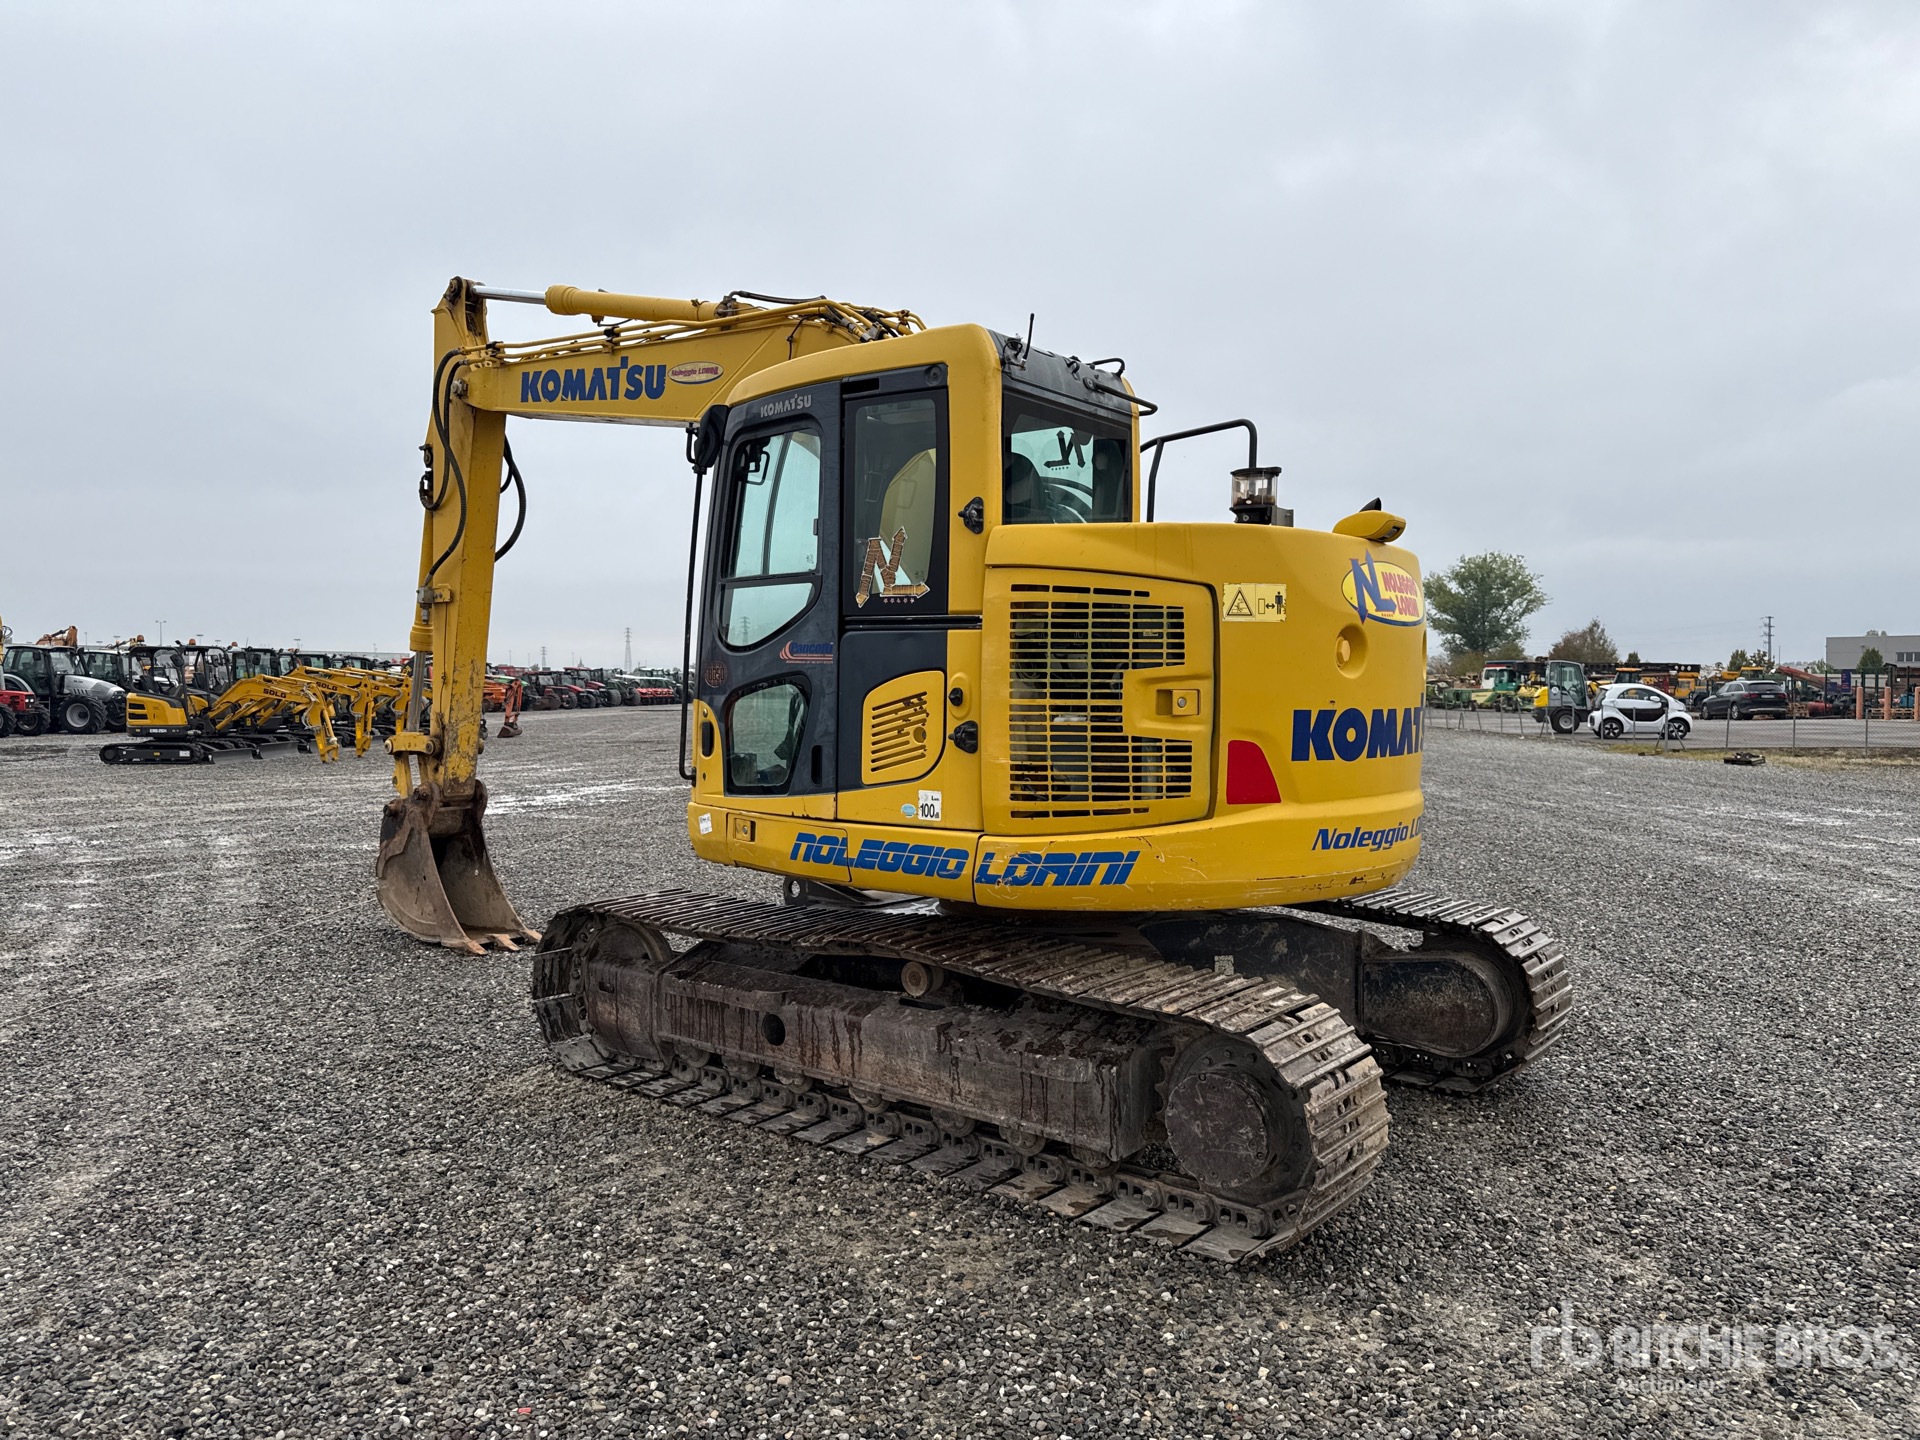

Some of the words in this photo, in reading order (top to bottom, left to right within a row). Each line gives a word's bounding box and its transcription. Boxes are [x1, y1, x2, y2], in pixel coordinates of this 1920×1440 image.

[521, 356, 667, 403] KOMATSU
[760, 393, 812, 418] KOMATSU
[263, 688, 287, 699] SDLG
[316, 681, 338, 691] SDLG
[920, 803, 935, 818] 100
[1311, 822, 1409, 852] Noleggio
[789, 832, 970, 880] NOLEGGIO
